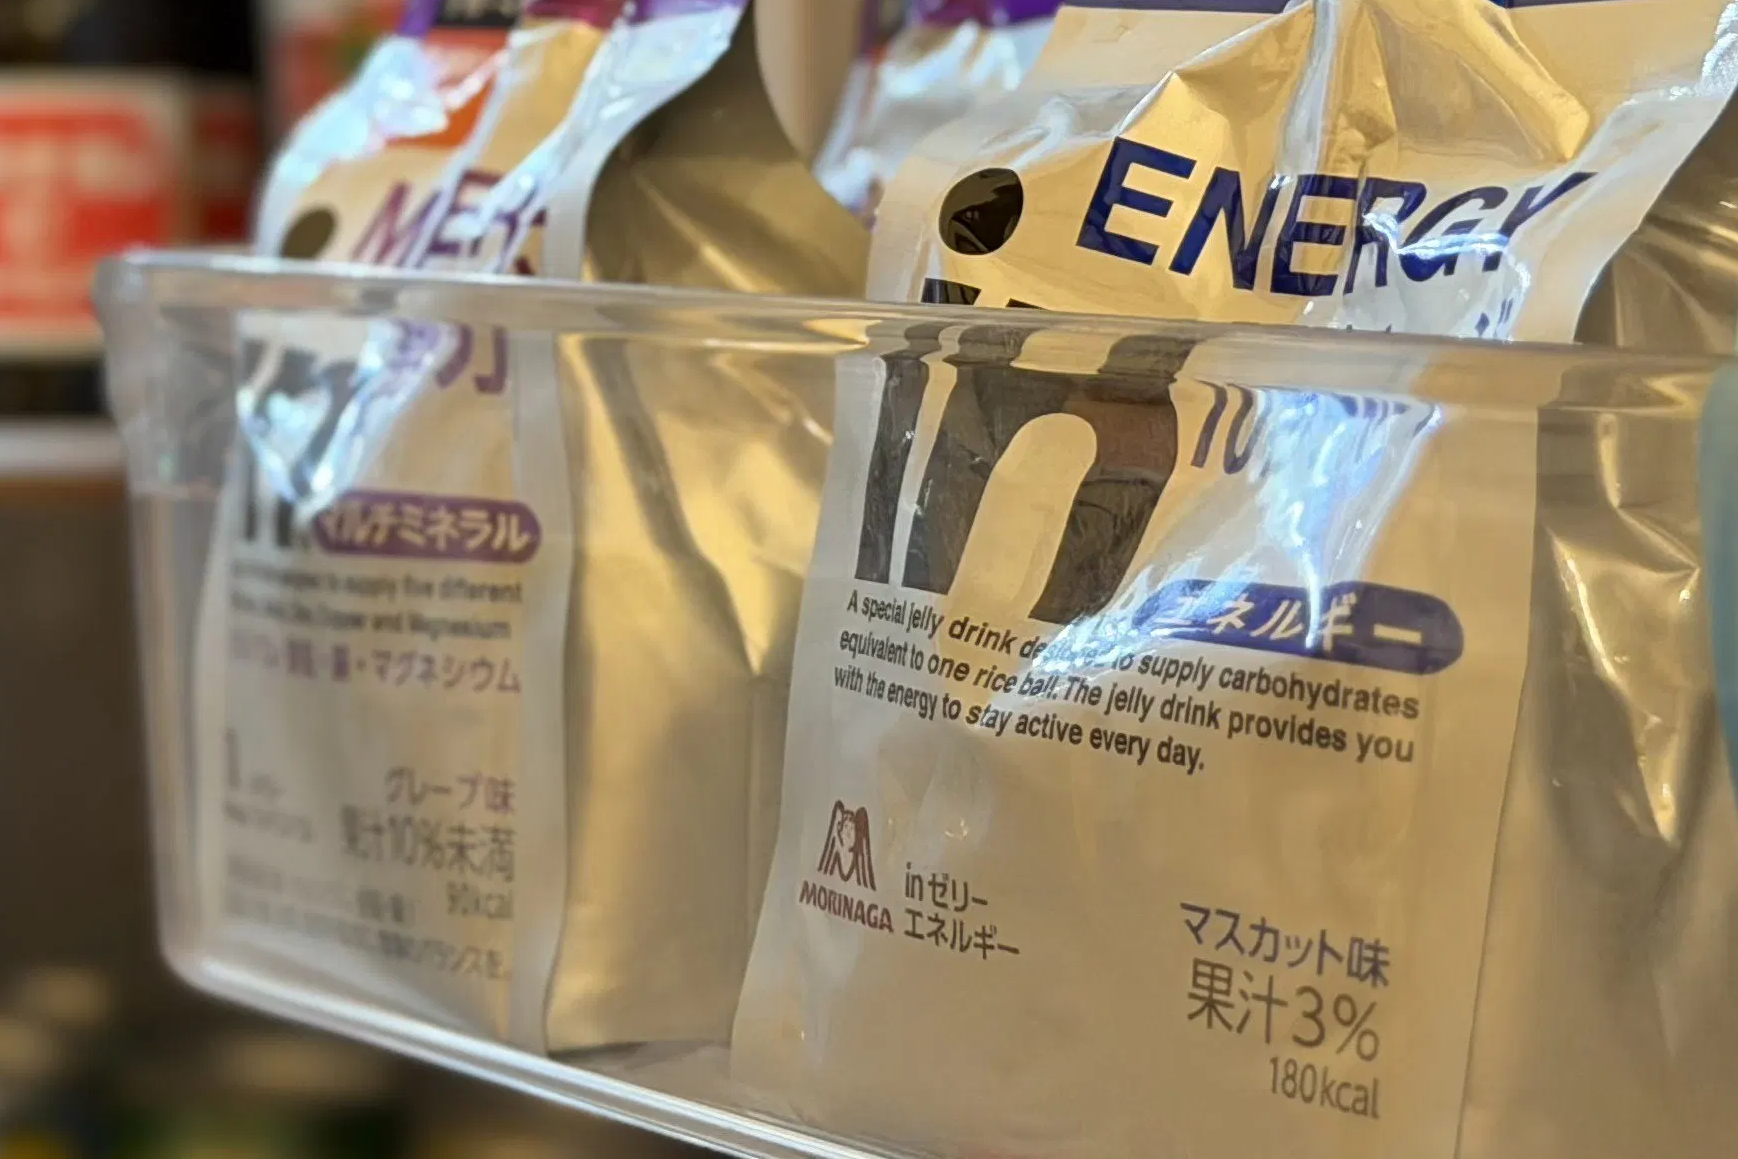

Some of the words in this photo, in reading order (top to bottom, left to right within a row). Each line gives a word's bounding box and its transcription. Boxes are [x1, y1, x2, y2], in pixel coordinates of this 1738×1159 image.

[1074, 134, 1598, 297] ENERGY
[839, 629, 908, 667] equivalent
[910, 647, 924, 671] to
[927, 656, 970, 682] one
[973, 665, 1018, 694] rice
[1063, 676, 1102, 707] The
[1104, 683, 1155, 723] jelly
[1160, 693, 1221, 730] drink
[1227, 709, 1347, 753] provides
[1356, 731, 1415, 764] you
[847, 589, 858, 613] A
[861, 597, 905, 624] special
[905, 600, 944, 639] jelly
[949, 616, 1017, 656] drink
[1137, 653, 1214, 691] supply
[1218, 666, 1419, 720] carbohydrates
[834, 665, 863, 690] with
[865, 671, 884, 700] the
[886, 682, 938, 720] energy
[942, 692, 961, 721] to
[965, 703, 1013, 737] stay
[1014, 712, 1084, 746] active
[1089, 726, 1150, 766] every
[1156, 736, 1205, 775] day.
[799, 880, 894, 933] MORINAGA
[903, 907, 1020, 960] エネルギー
[1180, 902, 1391, 989] マスカット味
[1187, 957, 1381, 1062] 果汁3%
[1269, 1056, 1380, 1120] 180kcal
